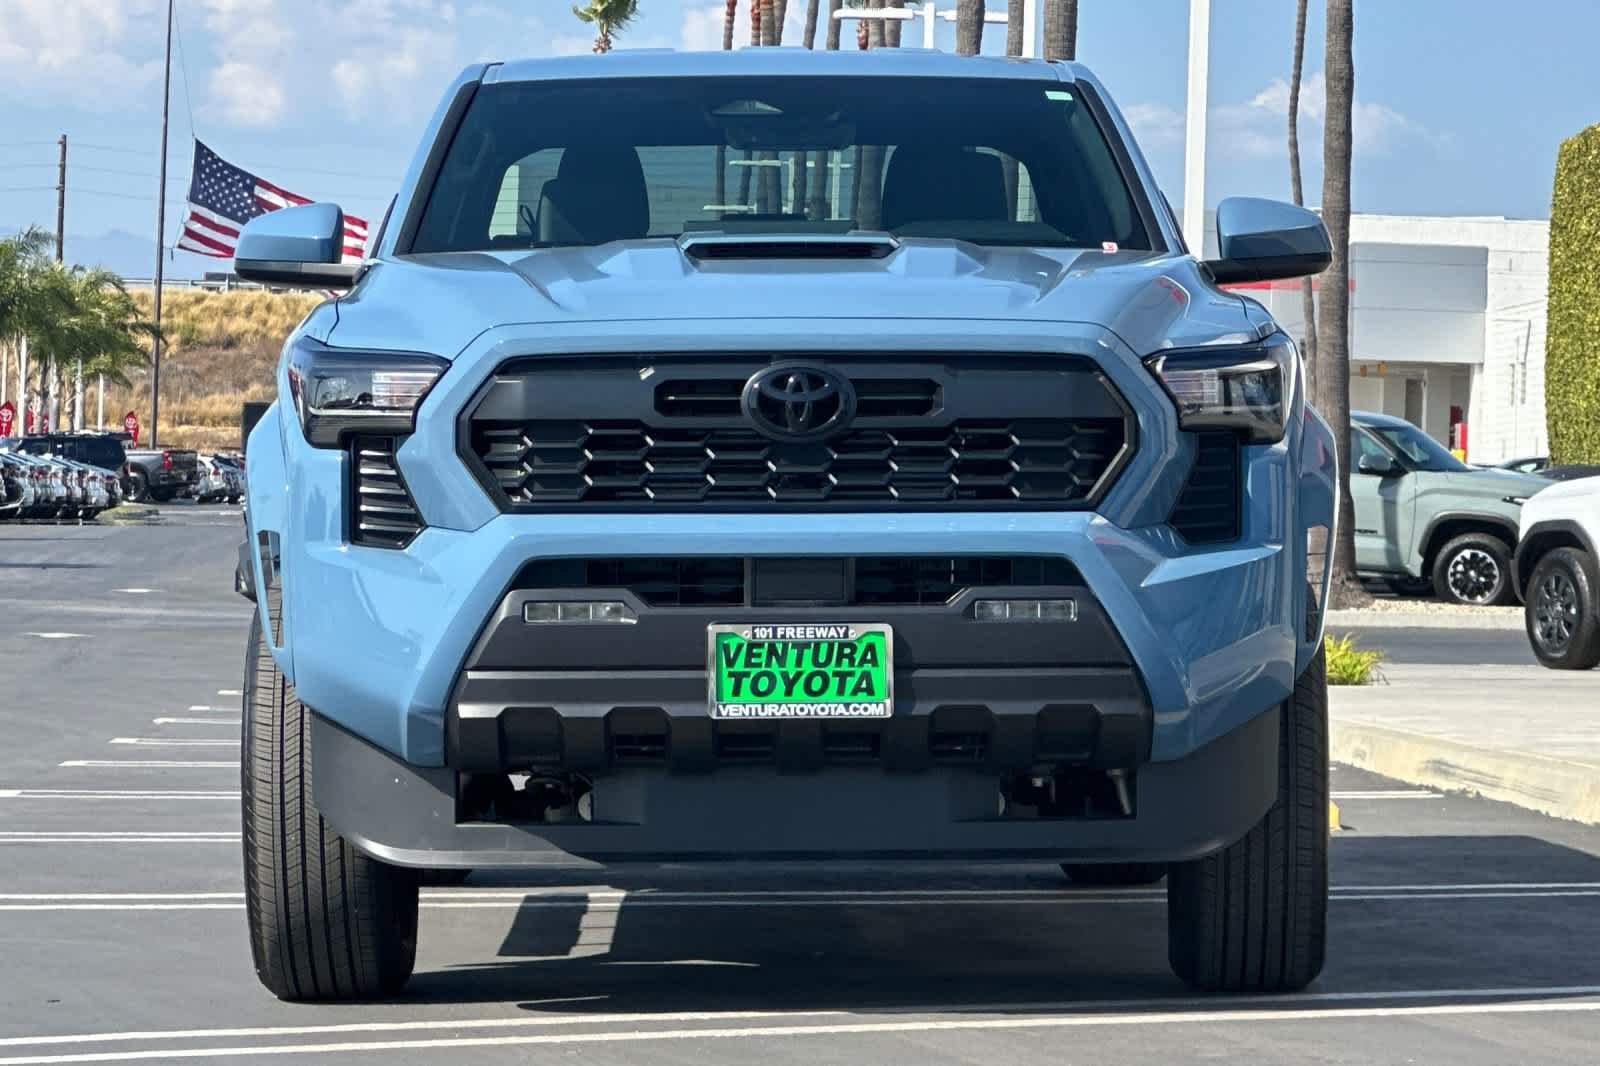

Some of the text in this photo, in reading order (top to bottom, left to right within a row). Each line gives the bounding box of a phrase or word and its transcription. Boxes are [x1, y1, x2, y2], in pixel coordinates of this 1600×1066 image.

[754, 627, 847, 639] 101 FREEWAY
[722, 641, 879, 668] VENTURA
[728, 670, 875, 698] TOYOTA
[719, 703, 884, 716] VENTURATOYOTA.COM
